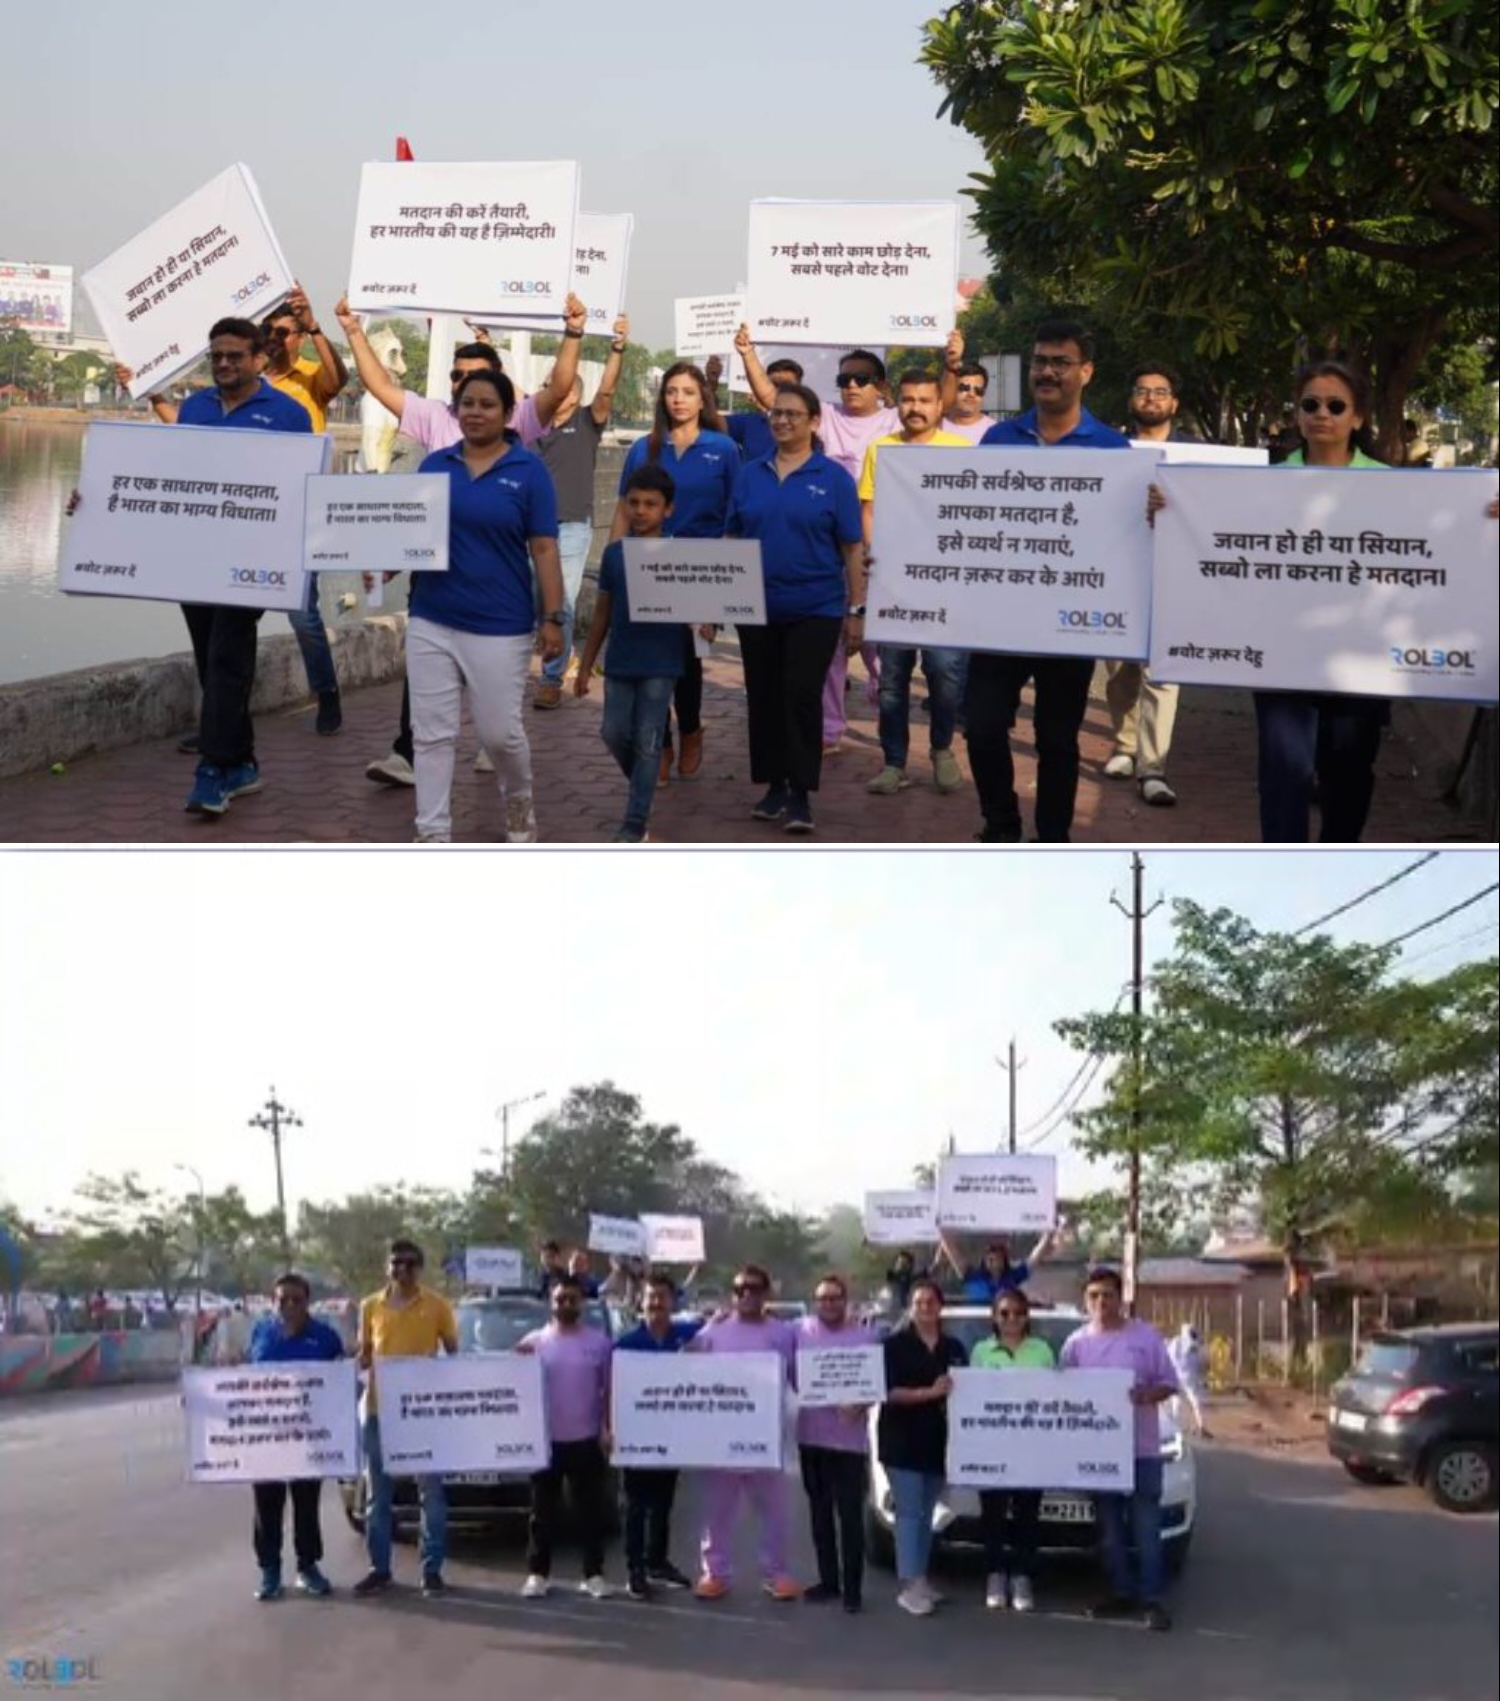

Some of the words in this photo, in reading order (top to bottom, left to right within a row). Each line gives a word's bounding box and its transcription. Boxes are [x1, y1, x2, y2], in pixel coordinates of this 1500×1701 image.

[399, 206, 442, 219] मतदान
[445, 203, 463, 219] की
[466, 202, 486, 219] करें
[489, 203, 530, 220] तैयारी,
[370, 226, 386, 238] हर
[389, 223, 435, 238] भारतीय
[438, 223, 456, 238] की
[459, 226, 479, 239] यह
[481, 223, 490, 239] है
[771, 247, 778, 257] 7
[781, 243, 799, 259] मई
[802, 244, 819, 257] को
[821, 244, 844, 257] सारे
[846, 246, 874, 258] काम
[876, 244, 901, 261] छोड़
[904, 243, 930, 260] देना,
[125, 275, 154, 302] जवान
[155, 265, 166, 282] हो
[166, 258, 178, 274] ही
[178, 248, 191, 264] या
[791, 262, 822, 276] सबसे
[825, 263, 853, 276] पहले
[856, 263, 878, 276] वोट
[881, 262, 908, 278] देना।
[153, 289, 166, 306] ला
[168, 270, 194, 293] करना
[112, 475, 130, 490] हर
[134, 477, 158, 493] एक
[161, 480, 217, 496] साधारण
[221, 482, 280, 501] मतदाता,
[921, 470, 978, 492] आपकी
[981, 471, 1045, 493] सर्वश्रेष्ठ
[1050, 476, 1104, 493] ताकत
[107, 494, 118, 513] है
[121, 499, 155, 515] भारत
[159, 500, 179, 516] का
[183, 502, 218, 519] भाग्य
[220, 501, 277, 523] विधाता।
[938, 503, 995, 522] आपका
[1000, 504, 1057, 524] मतदान
[1061, 502, 1079, 526] है,
[937, 531, 963, 553] इसे
[967, 531, 1005, 553] व्यर्थ
[1007, 536, 1020, 554] न
[1024, 534, 1074, 557] गवाएं,
[1213, 532, 1270, 551] जवान
[1276, 530, 1297, 553] हो
[1303, 530, 1321, 555] ही
[1328, 535, 1352, 554] या
[1359, 531, 1433, 558] सियान,
[905, 564, 960, 583] मतदान
[963, 567, 1004, 586] ज़रूर
[1008, 569, 1034, 587] कर
[1039, 566, 1058, 587] के
[1061, 565, 1105, 588] आएं।
[1199, 557, 1249, 579] सब्बो
[1254, 562, 1281, 581] ला
[1287, 563, 1341, 583] करना
[1348, 560, 1362, 586] हे
[1366, 566, 1446, 587] मतदान।
[878, 605, 907, 621] #वोट
[1168, 642, 1204, 658] #वोट
[1243, 645, 1264, 668] देहु
